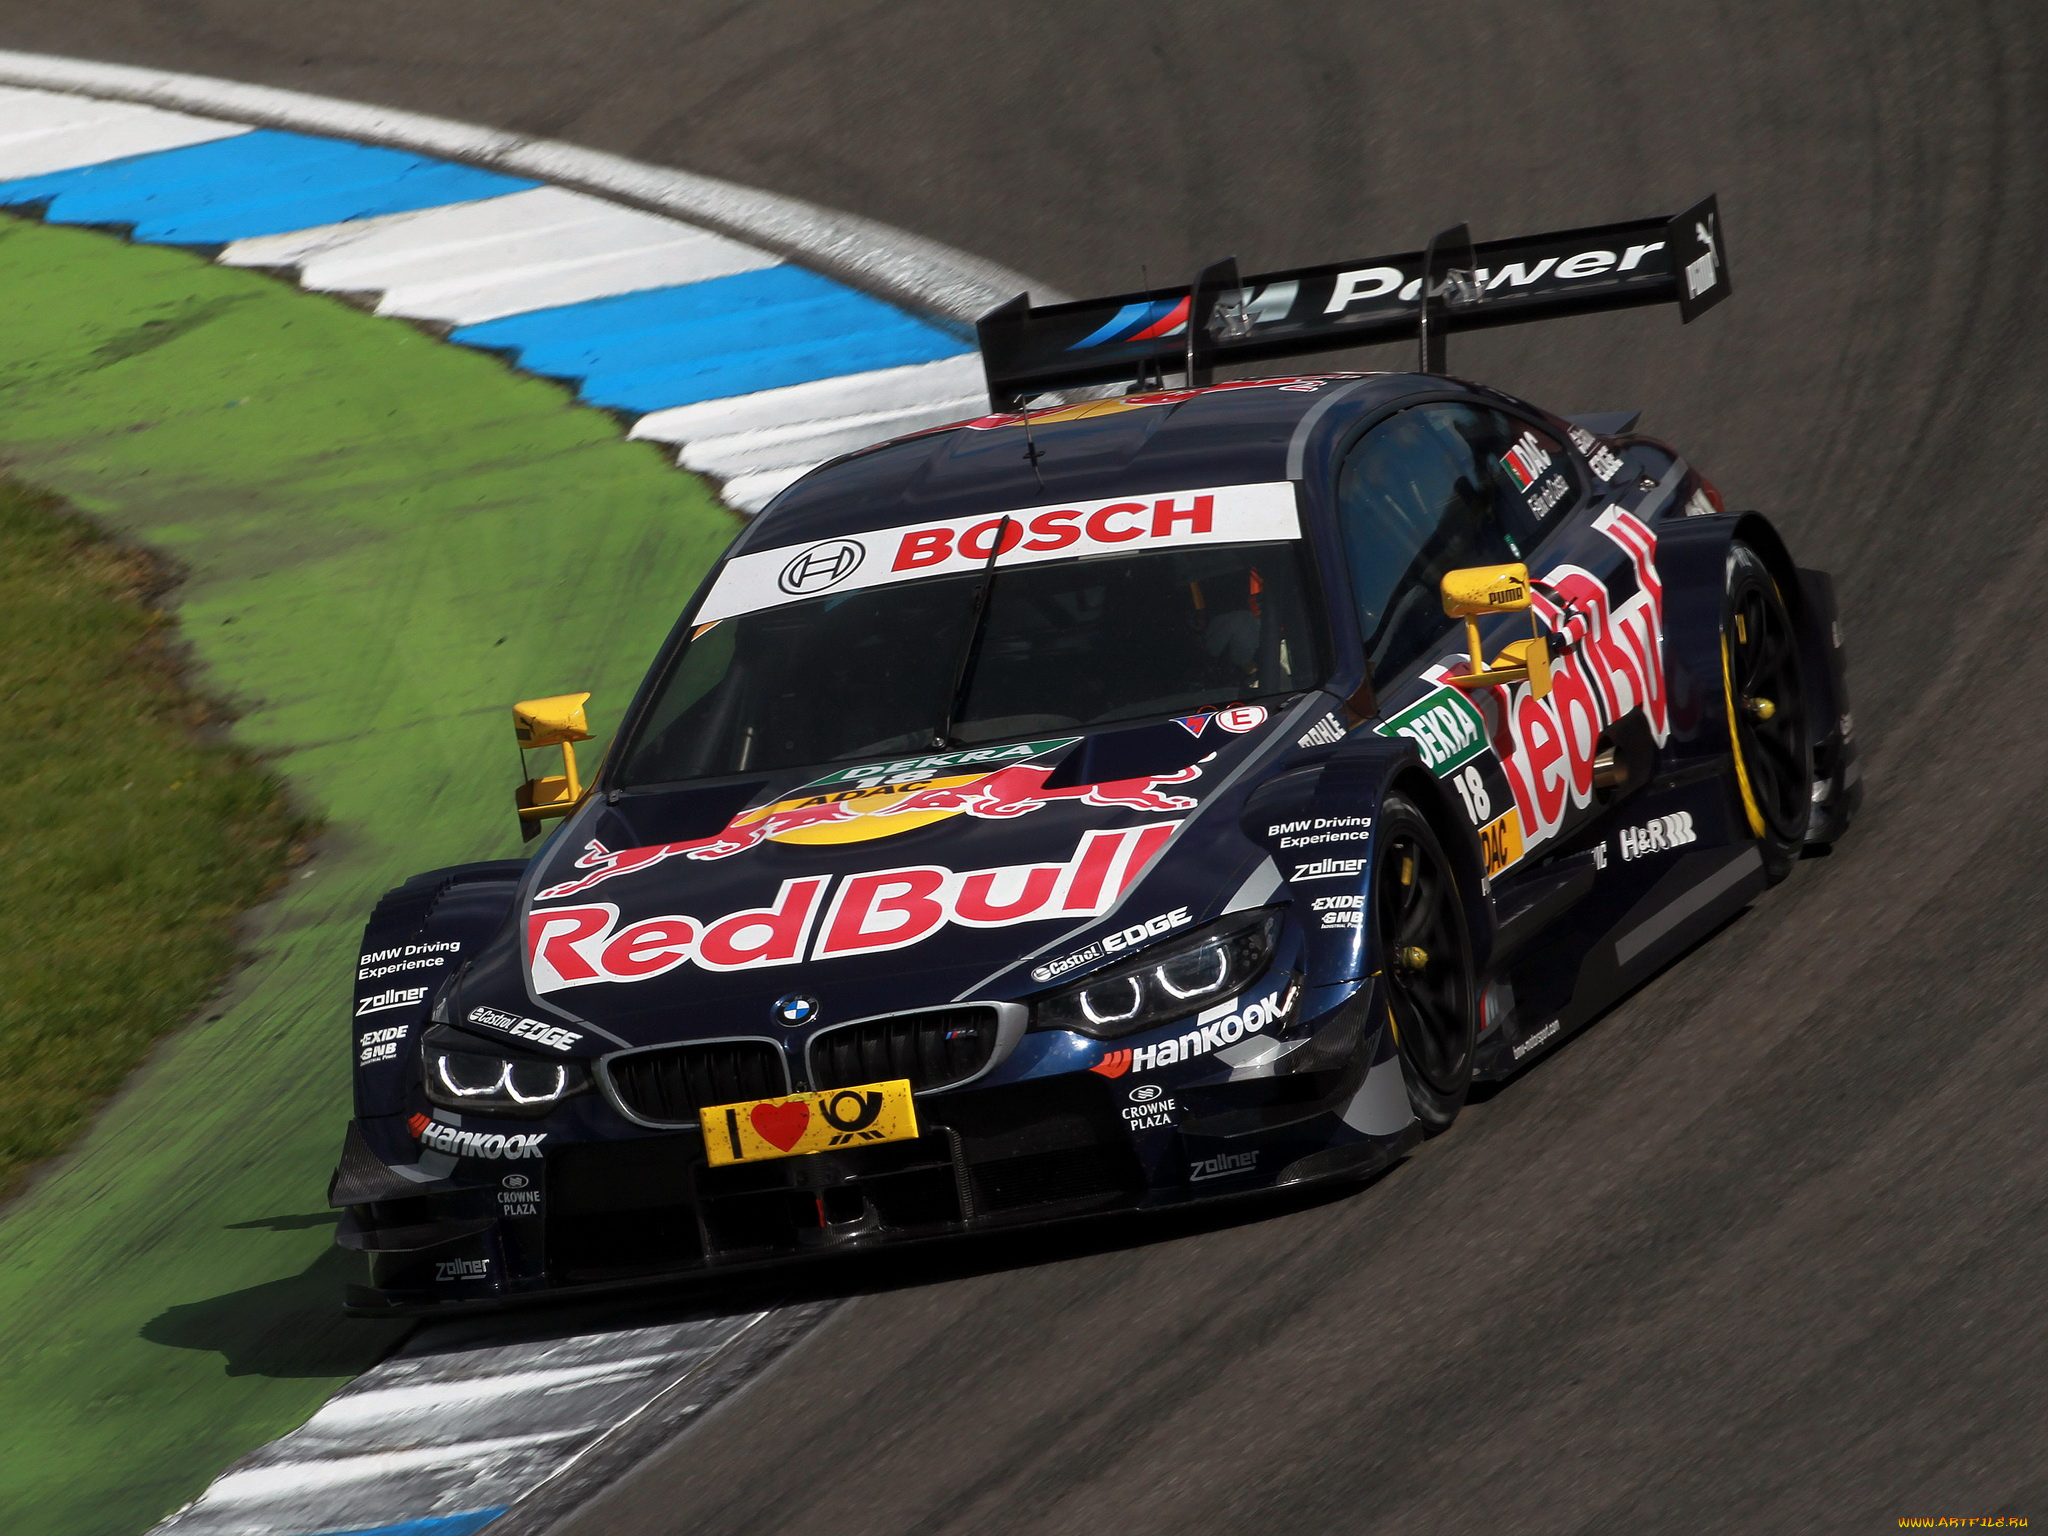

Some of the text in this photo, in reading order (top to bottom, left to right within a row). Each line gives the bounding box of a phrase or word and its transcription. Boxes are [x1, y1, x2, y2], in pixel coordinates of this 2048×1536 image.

[1323, 241, 1666, 314] Power
[1511, 431, 1552, 481] DAC
[890, 494, 1215, 573] BOSCH
[1488, 586, 1524, 605] PUMA
[1231, 708, 1253, 726] E
[1396, 697, 1479, 770] DEKRA
[840, 744, 1034, 780] DEKRA
[855, 769, 938, 790] 18
[796, 780, 933, 809] ADAC
[1452, 764, 1491, 826] 18
[1268, 815, 1372, 836] BMW Driving
[1280, 831, 1370, 849] Experience
[1481, 818, 1508, 874] DAC
[1312, 895, 1367, 911] EXIDE
[1323, 911, 1364, 924] GNB
[1049, 906, 1193, 976] Castrol EDGE
[360, 941, 461, 966] BMW Driving
[358, 957, 445, 980] Experience
[361, 1025, 409, 1047] EXIDE
[478, 1010, 583, 1051] Castrol EDGE
[361, 1042, 397, 1061] GNB
[1122, 1098, 1176, 1121] CROWNE
[1130, 1113, 1171, 1131] PLAZA
[725, 1108, 744, 1160] I
[497, 1190, 541, 1204] CROWNE
[503, 1203, 537, 1216] PLAZA
